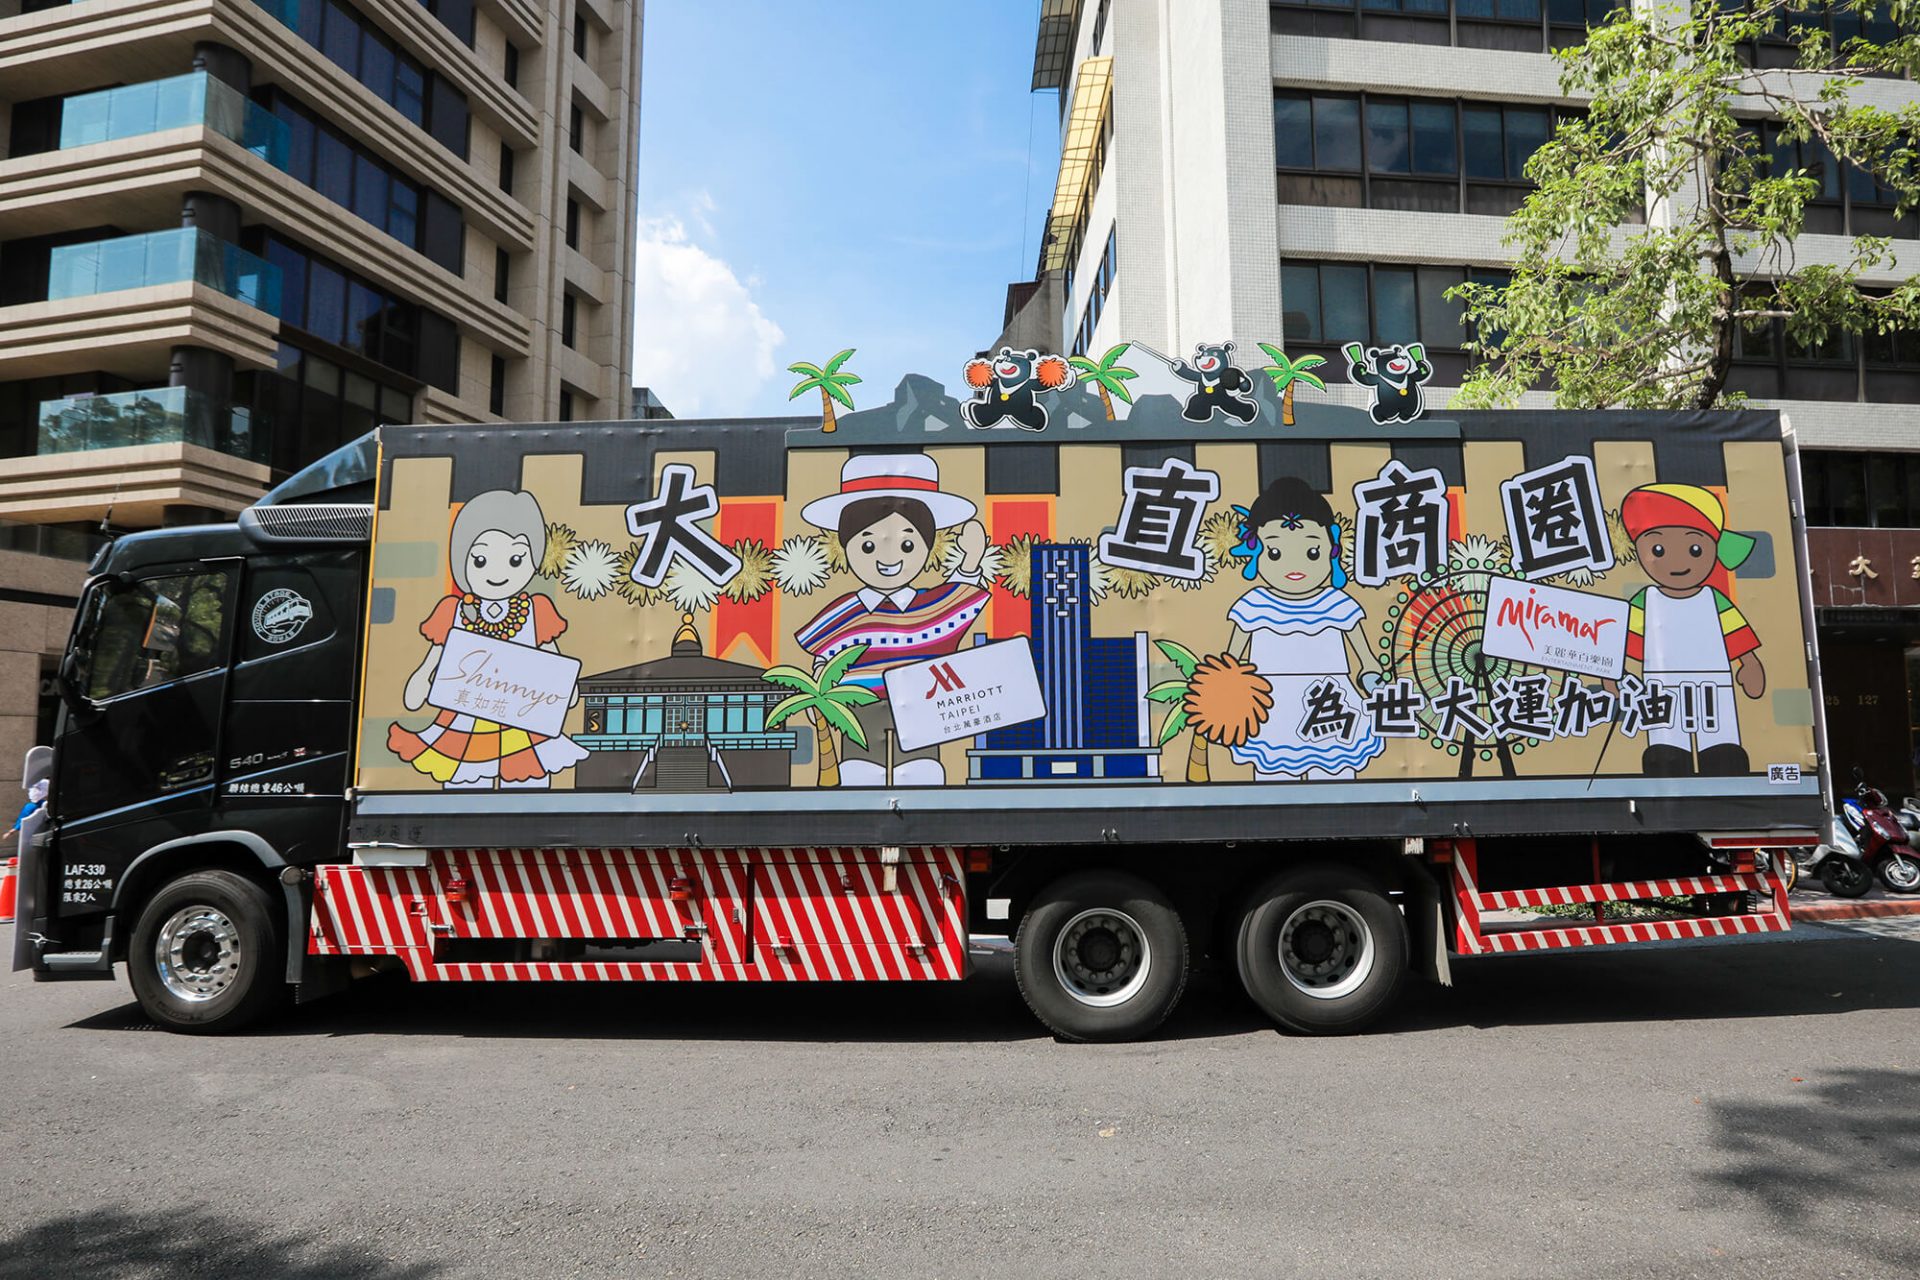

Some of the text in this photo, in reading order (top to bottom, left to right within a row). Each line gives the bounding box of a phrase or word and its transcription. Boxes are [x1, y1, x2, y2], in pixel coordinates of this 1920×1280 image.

[438, 649, 568, 718] Shinnyo
[453, 688, 511, 719] 真如苑
[936, 684, 1004, 710] MARRIOTT
[939, 704, 981, 721] TAIPEI
[943, 712, 1002, 734] 台北萬豪酒店
[229, 753, 264, 769] 540
[1770, 765, 1799, 782] 廣告
[64, 864, 106, 876] LAF-330
